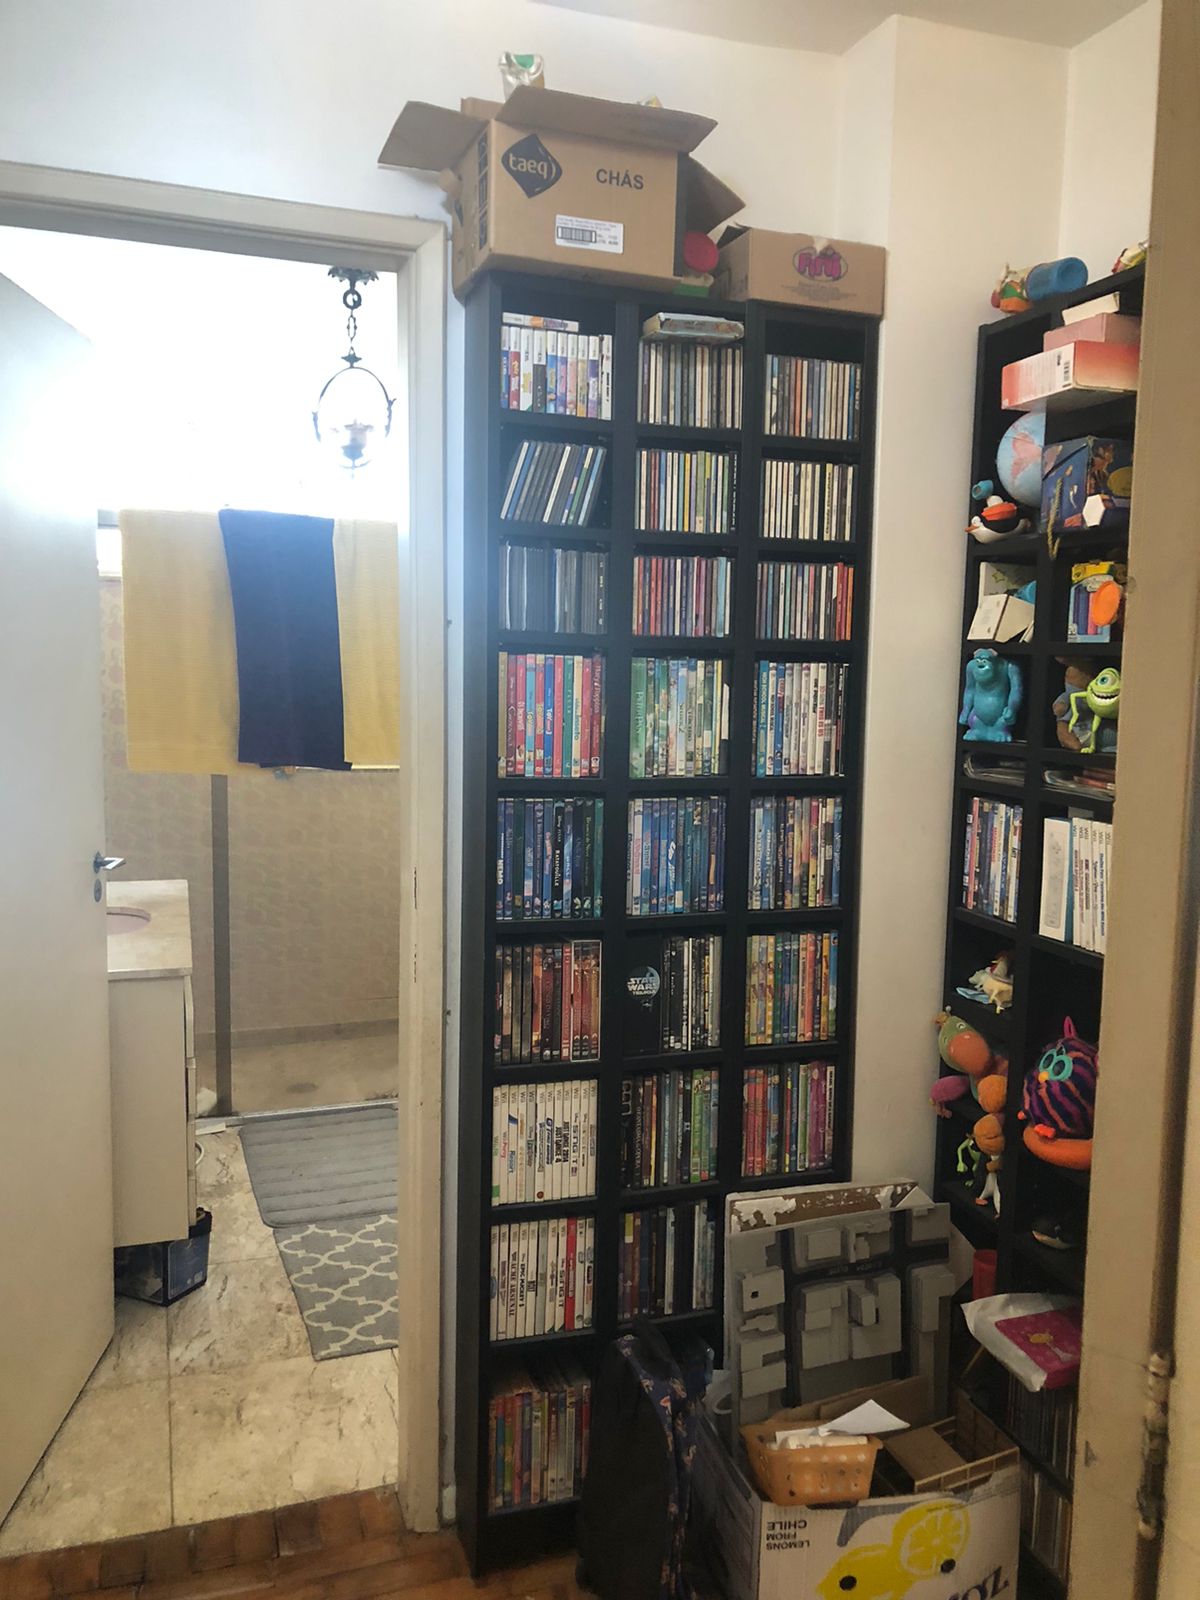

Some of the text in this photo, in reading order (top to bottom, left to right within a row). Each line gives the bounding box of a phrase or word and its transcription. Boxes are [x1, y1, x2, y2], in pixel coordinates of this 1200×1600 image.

[508, 153, 548, 180] taeq
[596, 169, 645, 190] CHÁS
[496, 859, 504, 885] NEMO
[627, 977, 657, 985] STAR
[627, 983, 657, 991] WARS
[509, 1150, 517, 1173] Resort
[509, 1285, 517, 1317] ARSENAL
[767, 1520, 807, 1531] CHILE
[766, 1532, 796, 1541] FROM
[766, 1540, 810, 1550] LEMONS
